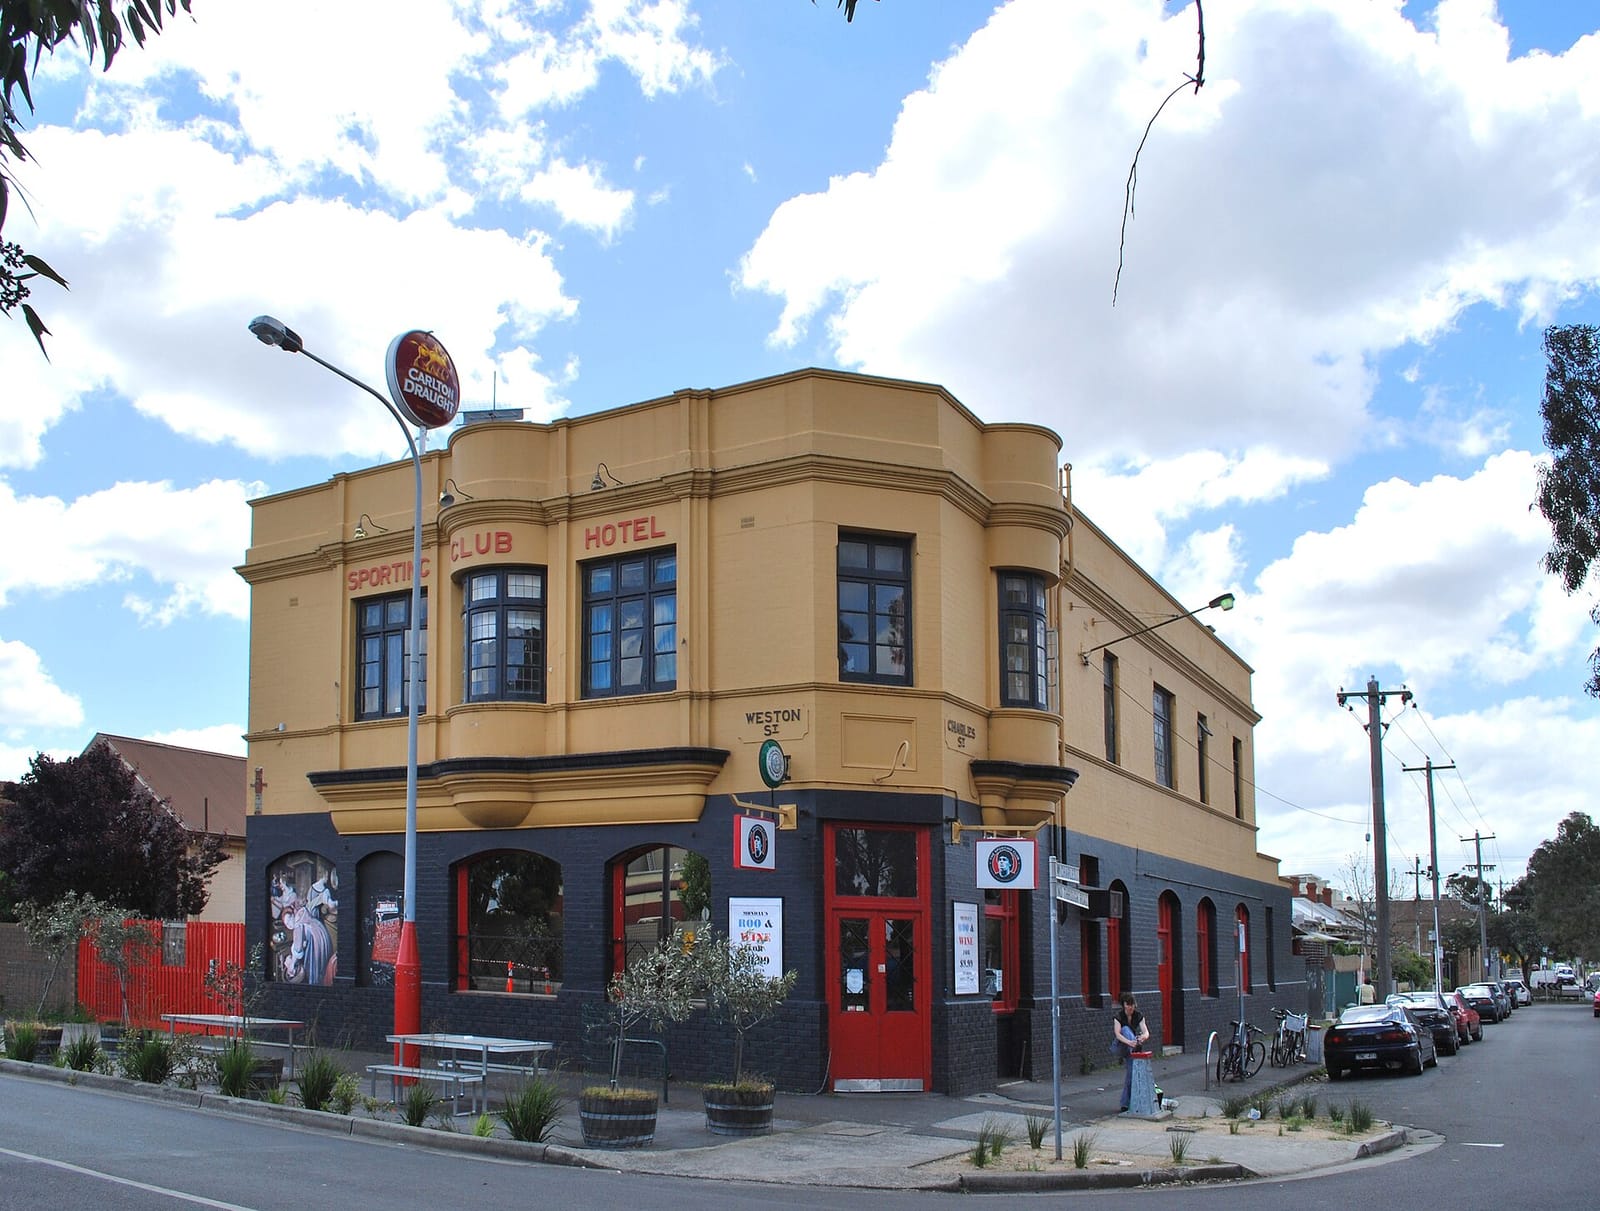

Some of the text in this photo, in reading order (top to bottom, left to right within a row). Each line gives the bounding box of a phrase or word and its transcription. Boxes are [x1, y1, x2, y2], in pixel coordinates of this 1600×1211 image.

[408, 367, 455, 398] CARLTON
[403, 379, 455, 414] DRAUGHT
[450, 531, 513, 562] CLUB
[585, 515, 666, 550] HOTEL
[746, 709, 800, 724] WESTON
[764, 724, 779, 736] ST
[947, 719, 976, 739] CHARLES
[739, 919, 773, 928] ROO &
[741, 932, 771, 942] WINE
[959, 936, 973, 946] WINE
